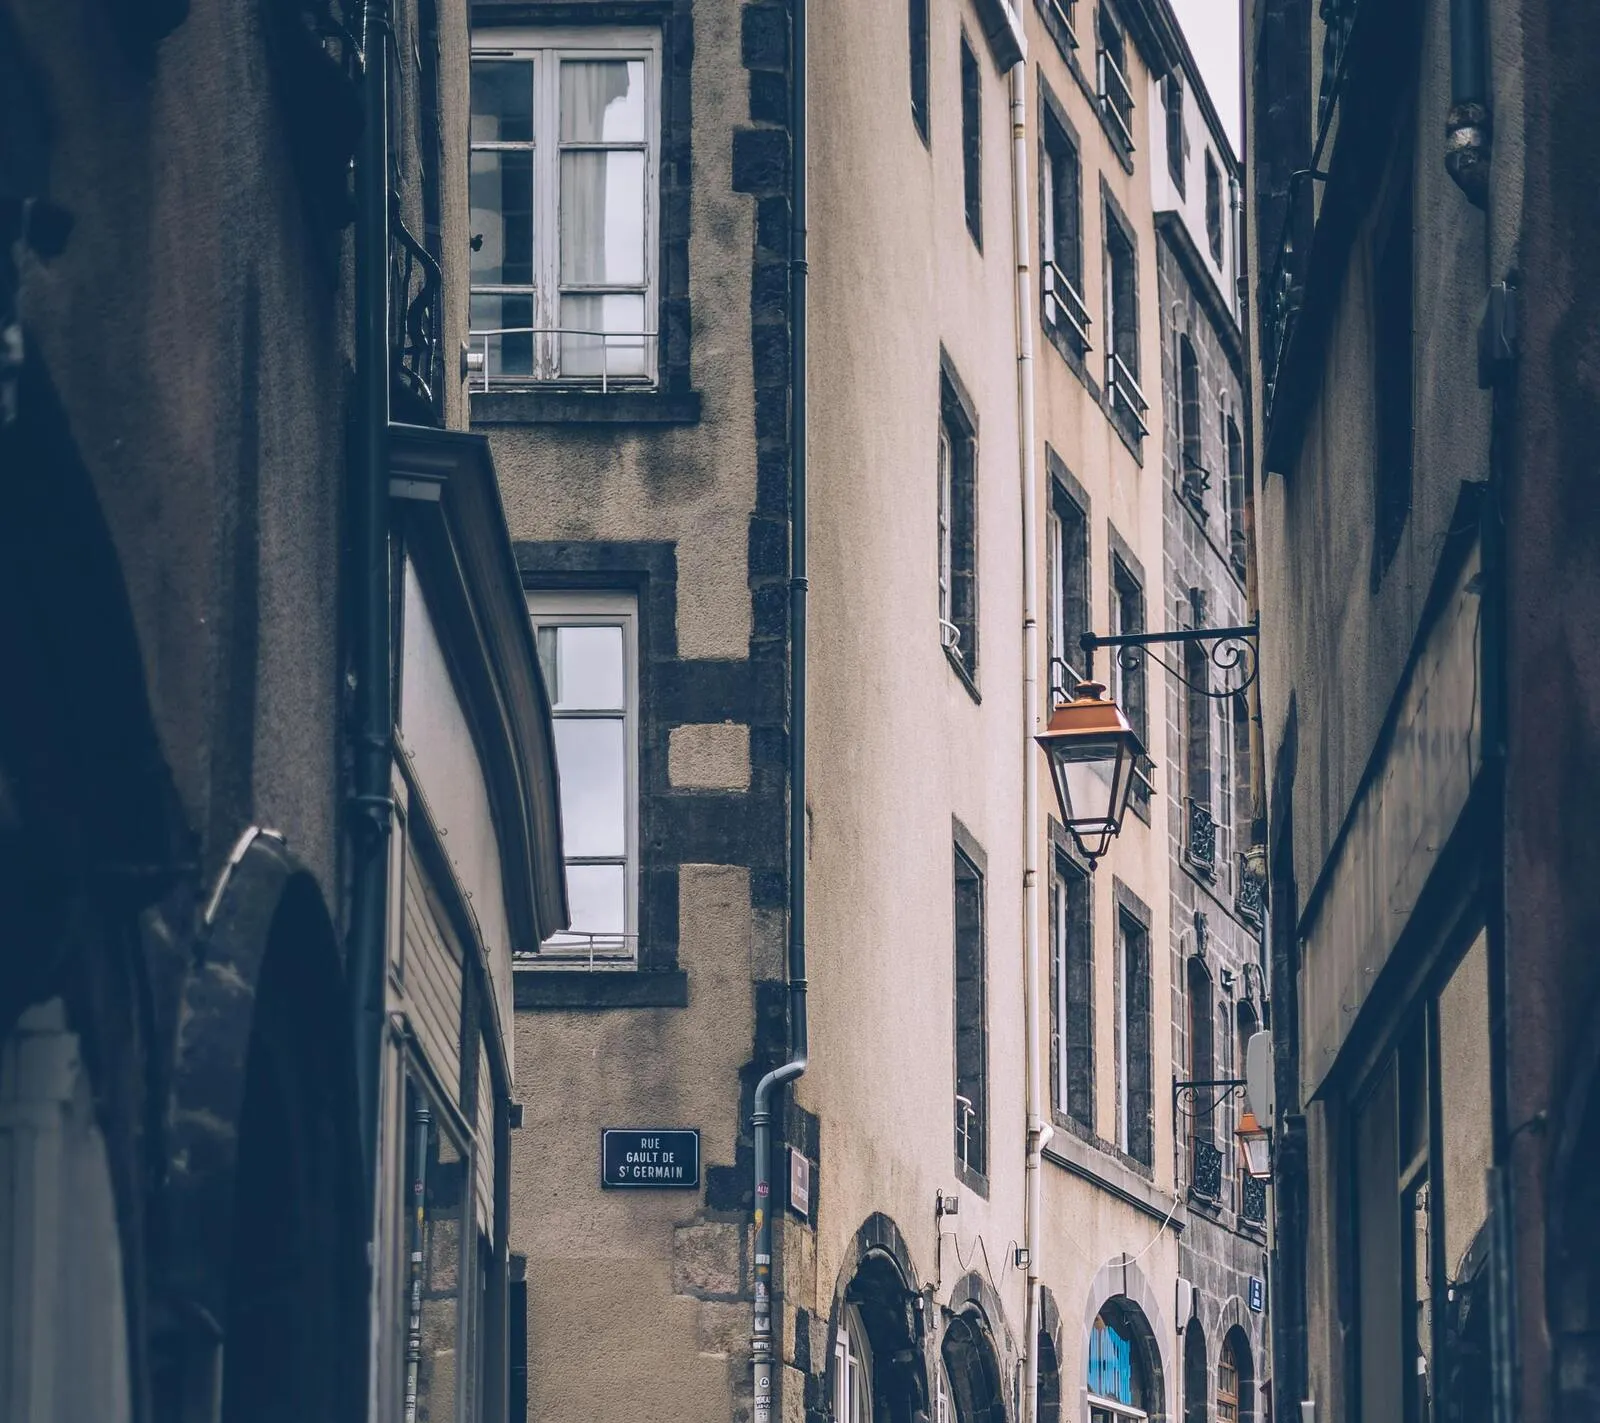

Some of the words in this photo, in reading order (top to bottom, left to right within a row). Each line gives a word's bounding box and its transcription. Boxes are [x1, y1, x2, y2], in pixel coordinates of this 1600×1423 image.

[641, 1138, 660, 1149] RUE
[626, 1152, 658, 1163] GAULT
[662, 1152, 674, 1163] DE
[633, 1166, 683, 1178] GERMAIN
